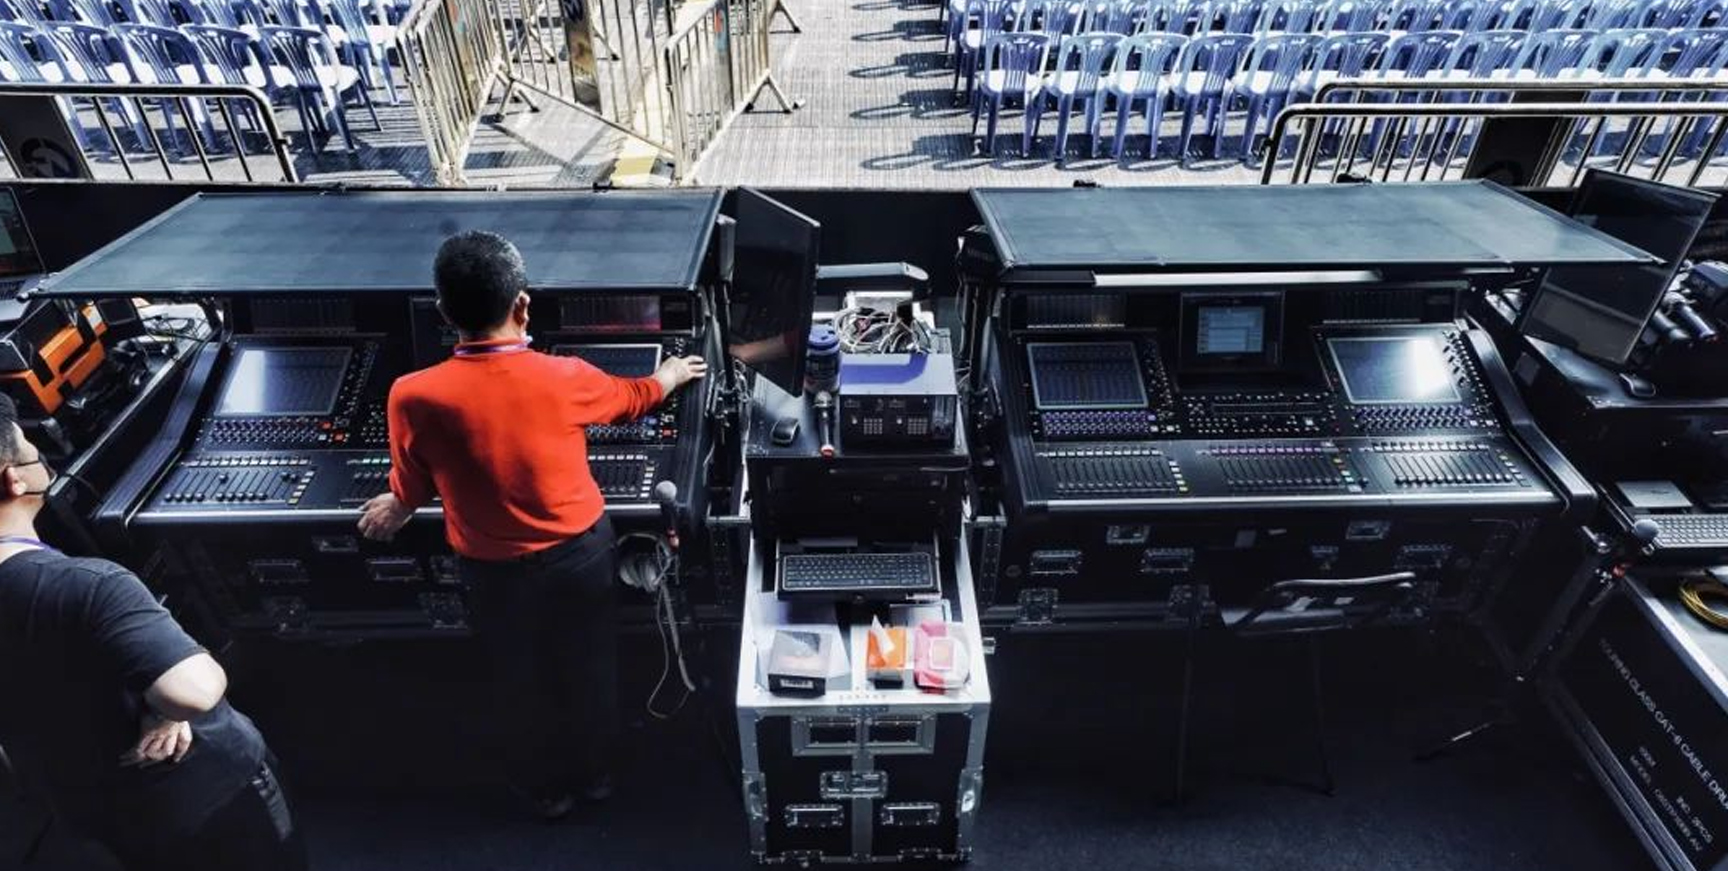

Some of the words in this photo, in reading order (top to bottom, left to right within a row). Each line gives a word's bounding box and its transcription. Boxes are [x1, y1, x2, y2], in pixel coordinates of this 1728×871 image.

[1629, 677, 1656, 712] CLASS
[1681, 743, 1711, 782] CABLE
[1708, 780, 1728, 810] DRU
